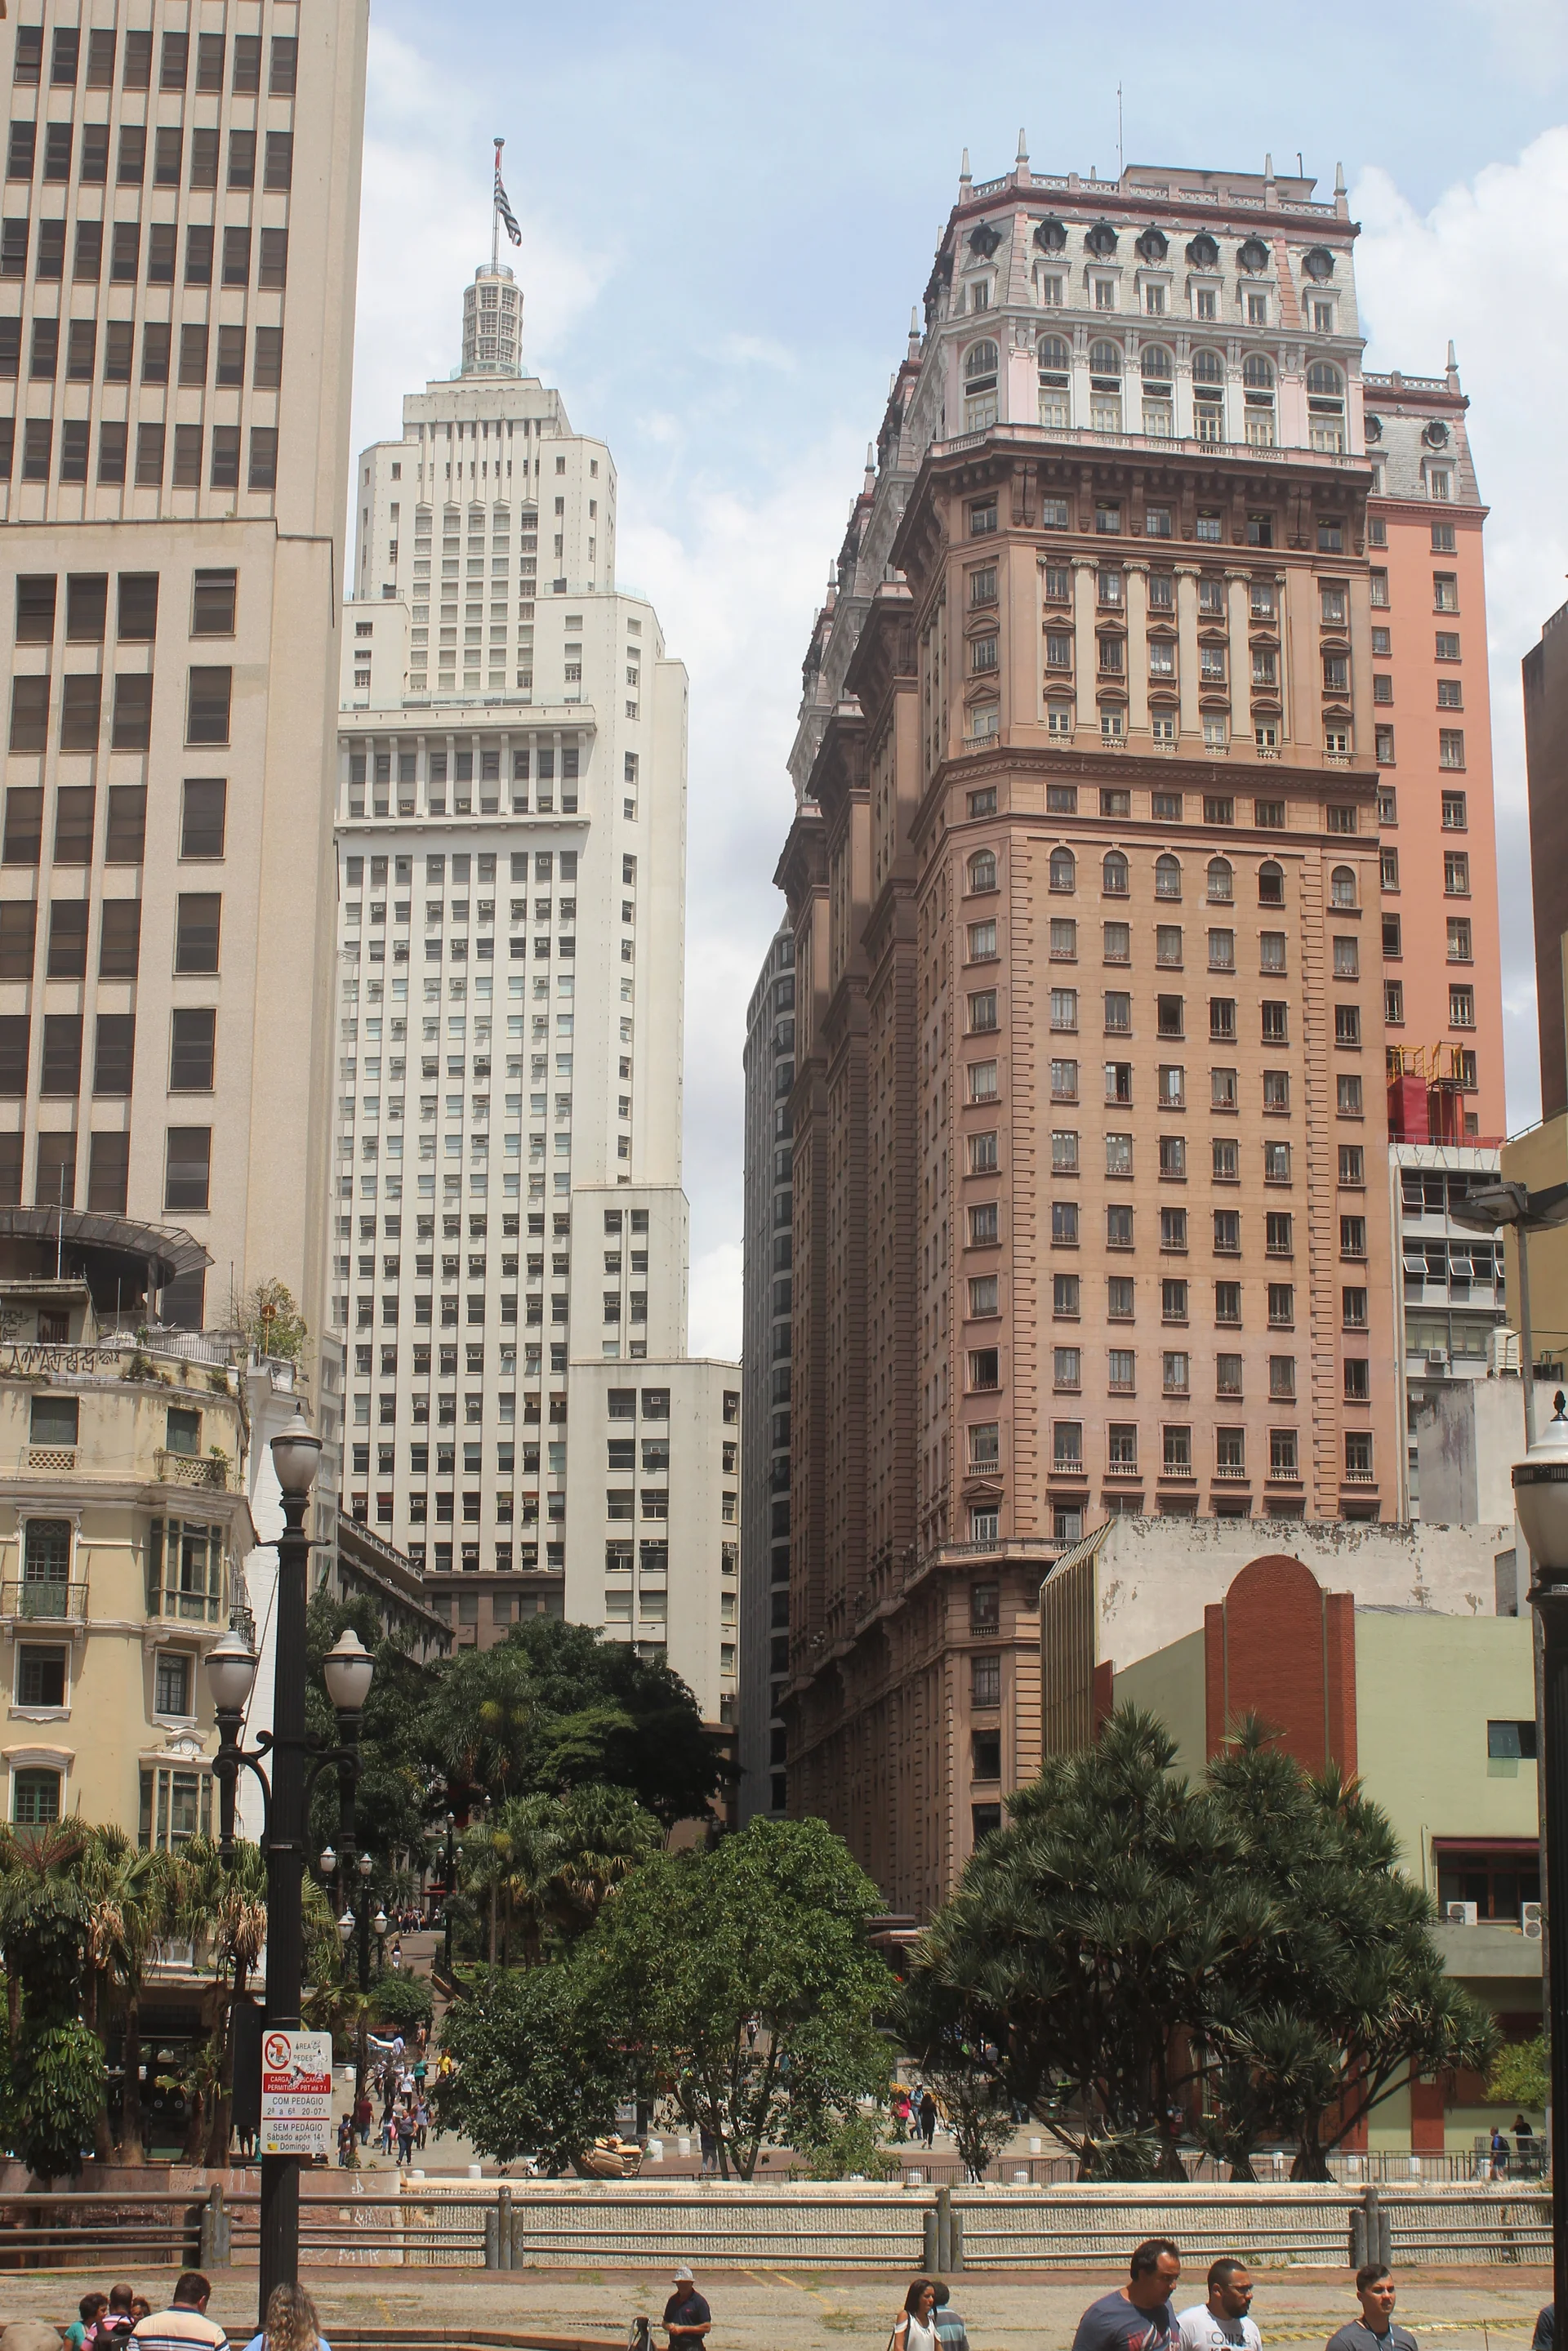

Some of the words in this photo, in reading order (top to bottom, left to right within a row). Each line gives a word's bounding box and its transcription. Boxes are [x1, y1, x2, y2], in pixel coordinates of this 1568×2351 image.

[292, 2095, 323, 2104] PEDÁGIO
[273, 2123, 288, 2131] SEM
[291, 2122, 323, 2131] PEDÁGIO
[266, 2132, 292, 2140] Sábado
[295, 2133, 310, 2142] após
[280, 2142, 310, 2152] Domingo
